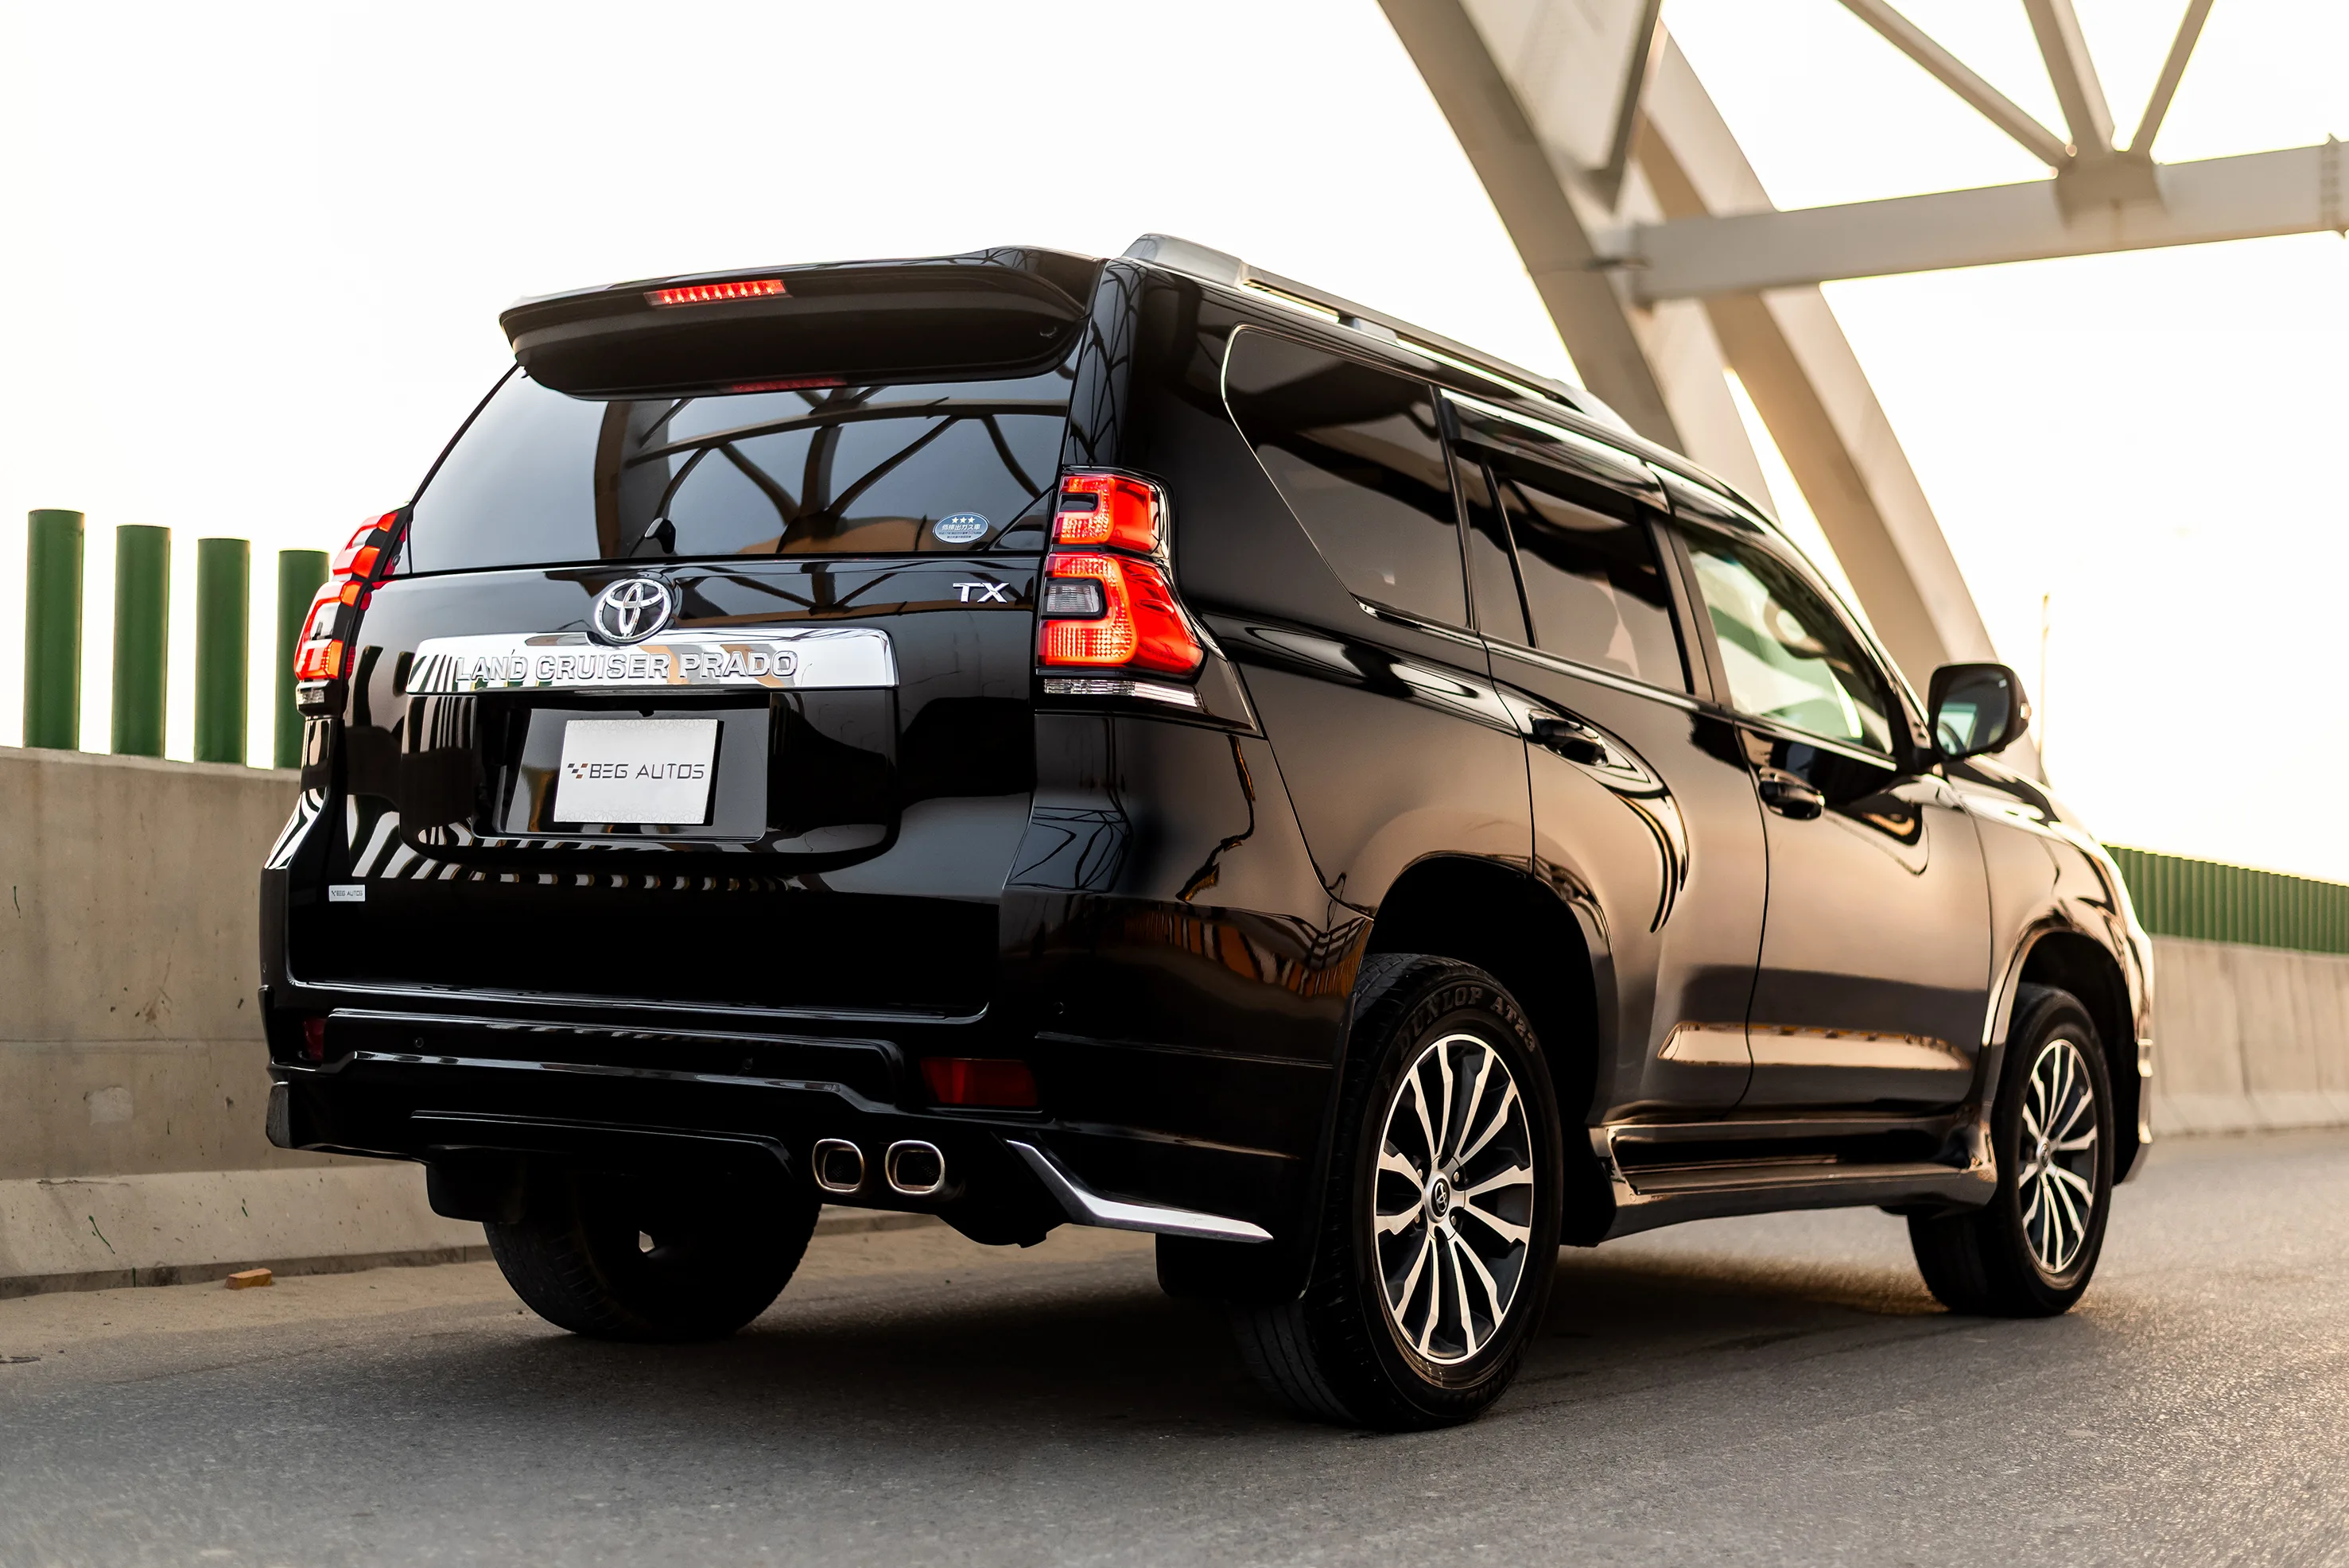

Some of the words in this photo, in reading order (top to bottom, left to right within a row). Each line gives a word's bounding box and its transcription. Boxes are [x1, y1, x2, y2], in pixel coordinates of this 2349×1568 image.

[953, 582, 1009, 603] TX
[455, 656, 528, 682] LAND
[535, 653, 670, 681] CRUISER
[678, 650, 798, 678] PRADO
[589, 763, 629, 779] BEG
[635, 763, 705, 779] AUTOS
[1397, 986, 1484, 1062] DUNLOP
